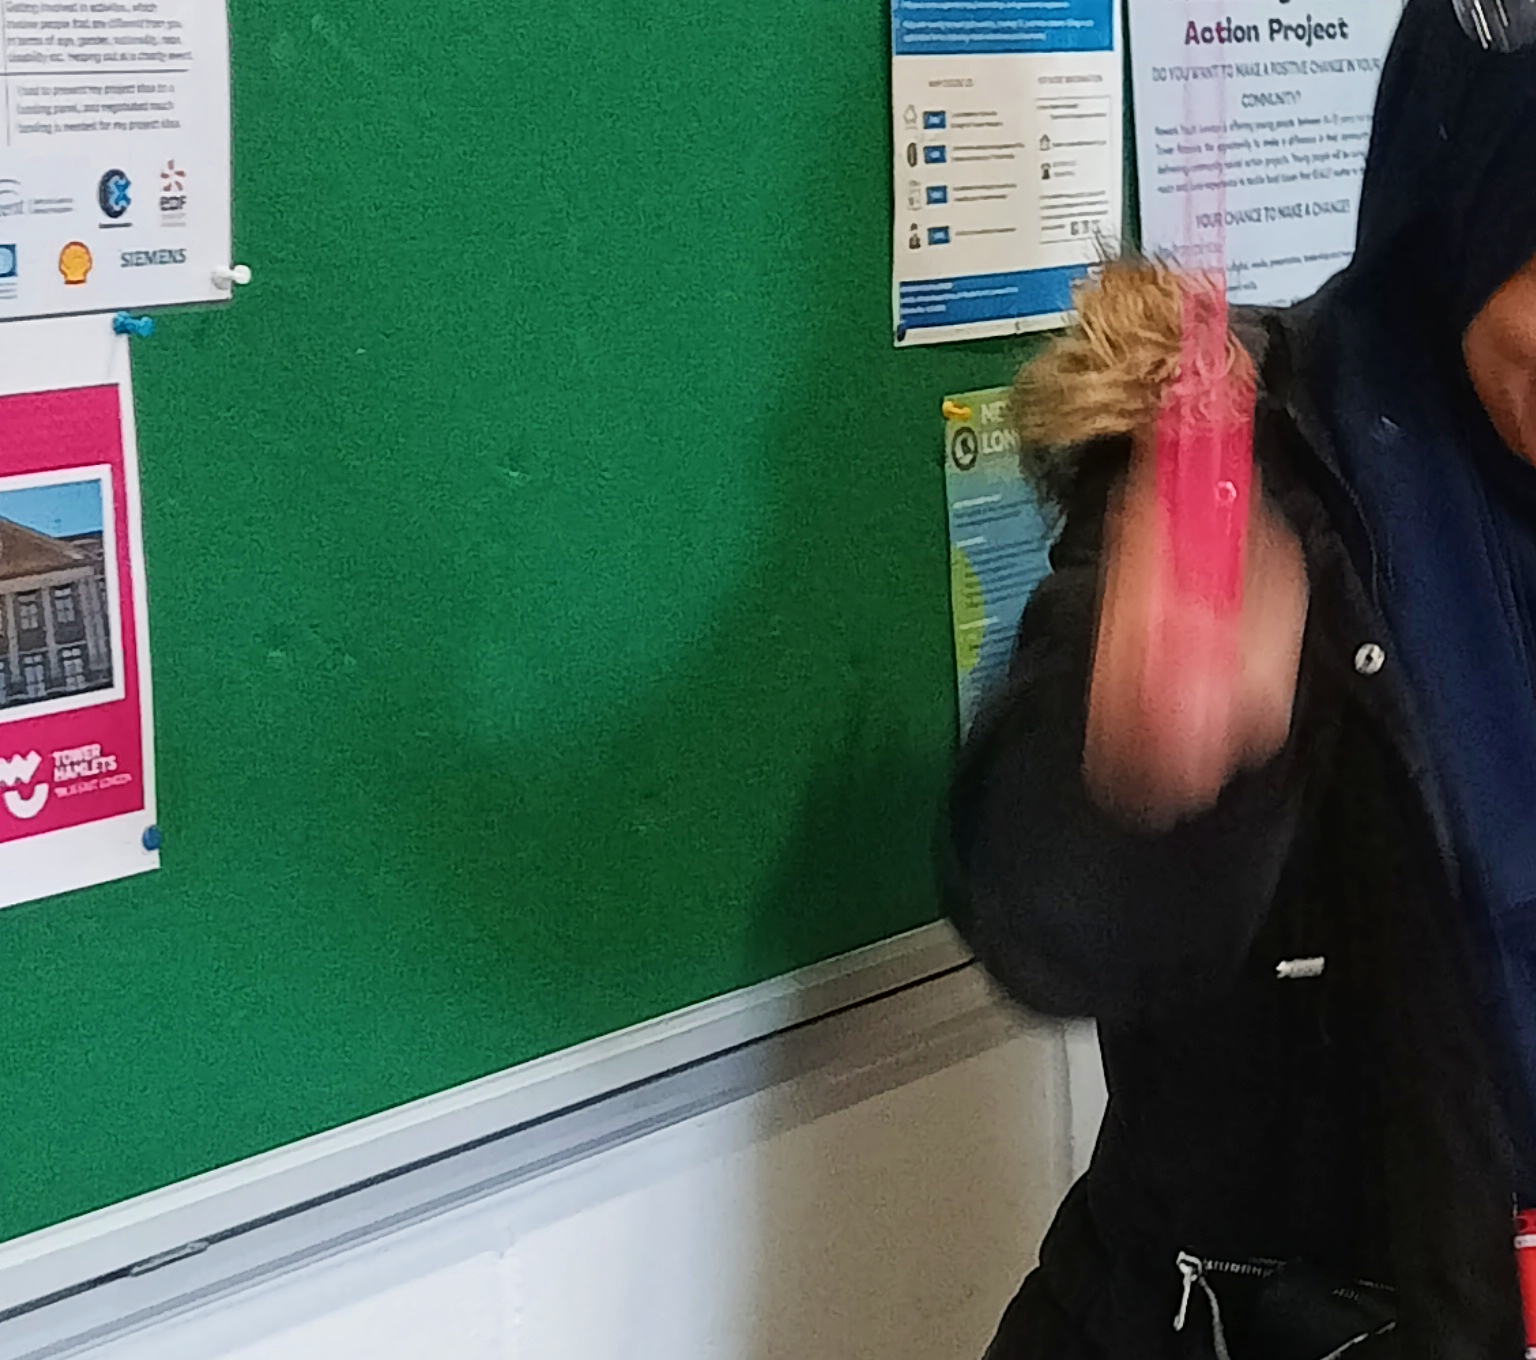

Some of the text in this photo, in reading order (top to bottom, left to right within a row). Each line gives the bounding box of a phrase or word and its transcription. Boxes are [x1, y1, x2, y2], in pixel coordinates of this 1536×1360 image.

[1184, 13, 1350, 48] Action Project
[119, 246, 188, 269] SIEMENS
[52, 743, 102, 767] TOWER
[53, 755, 118, 783] HAMLETS
